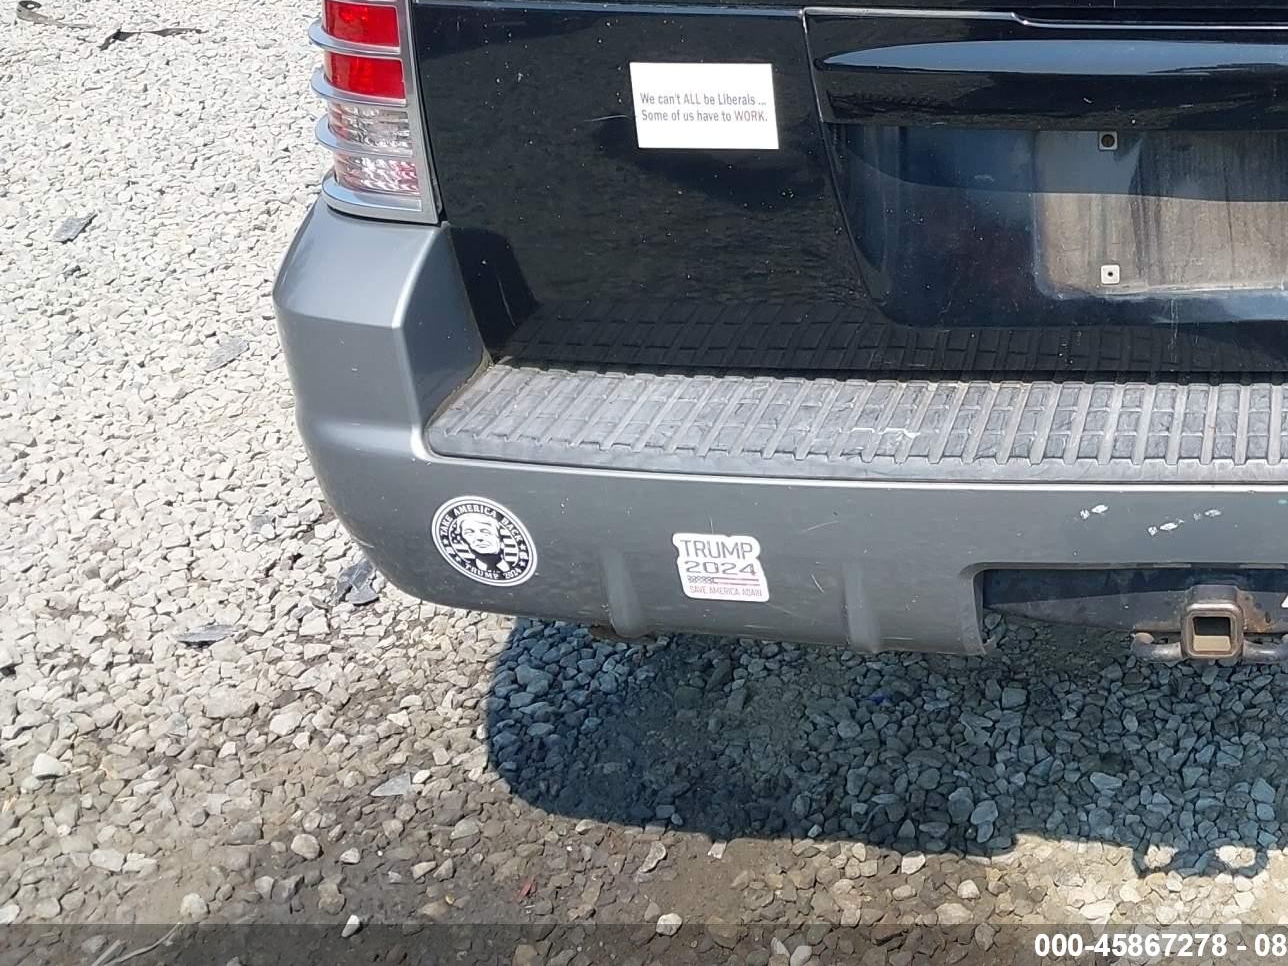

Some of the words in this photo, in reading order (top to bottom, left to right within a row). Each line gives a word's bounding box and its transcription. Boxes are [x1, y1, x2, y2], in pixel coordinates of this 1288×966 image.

[640, 92, 655, 105] We
[658, 92, 681, 105] can't
[683, 93, 702, 105] ALL
[704, 93, 715, 105] be
[718, 93, 756, 106] Liberals
[641, 109, 668, 121] Some
[671, 109, 681, 121] of
[683, 112, 694, 122] us
[697, 110, 719, 122] have
[721, 111, 732, 122] to
[734, 110, 768, 122] WORK.
[440, 514, 453, 535] TAKE
[453, 504, 497, 518] AMERICA
[500, 517, 523, 542] BACK
[680, 539, 753, 560] TRUMP
[465, 563, 500, 579] TRUMP
[684, 560, 757, 576] 2024
